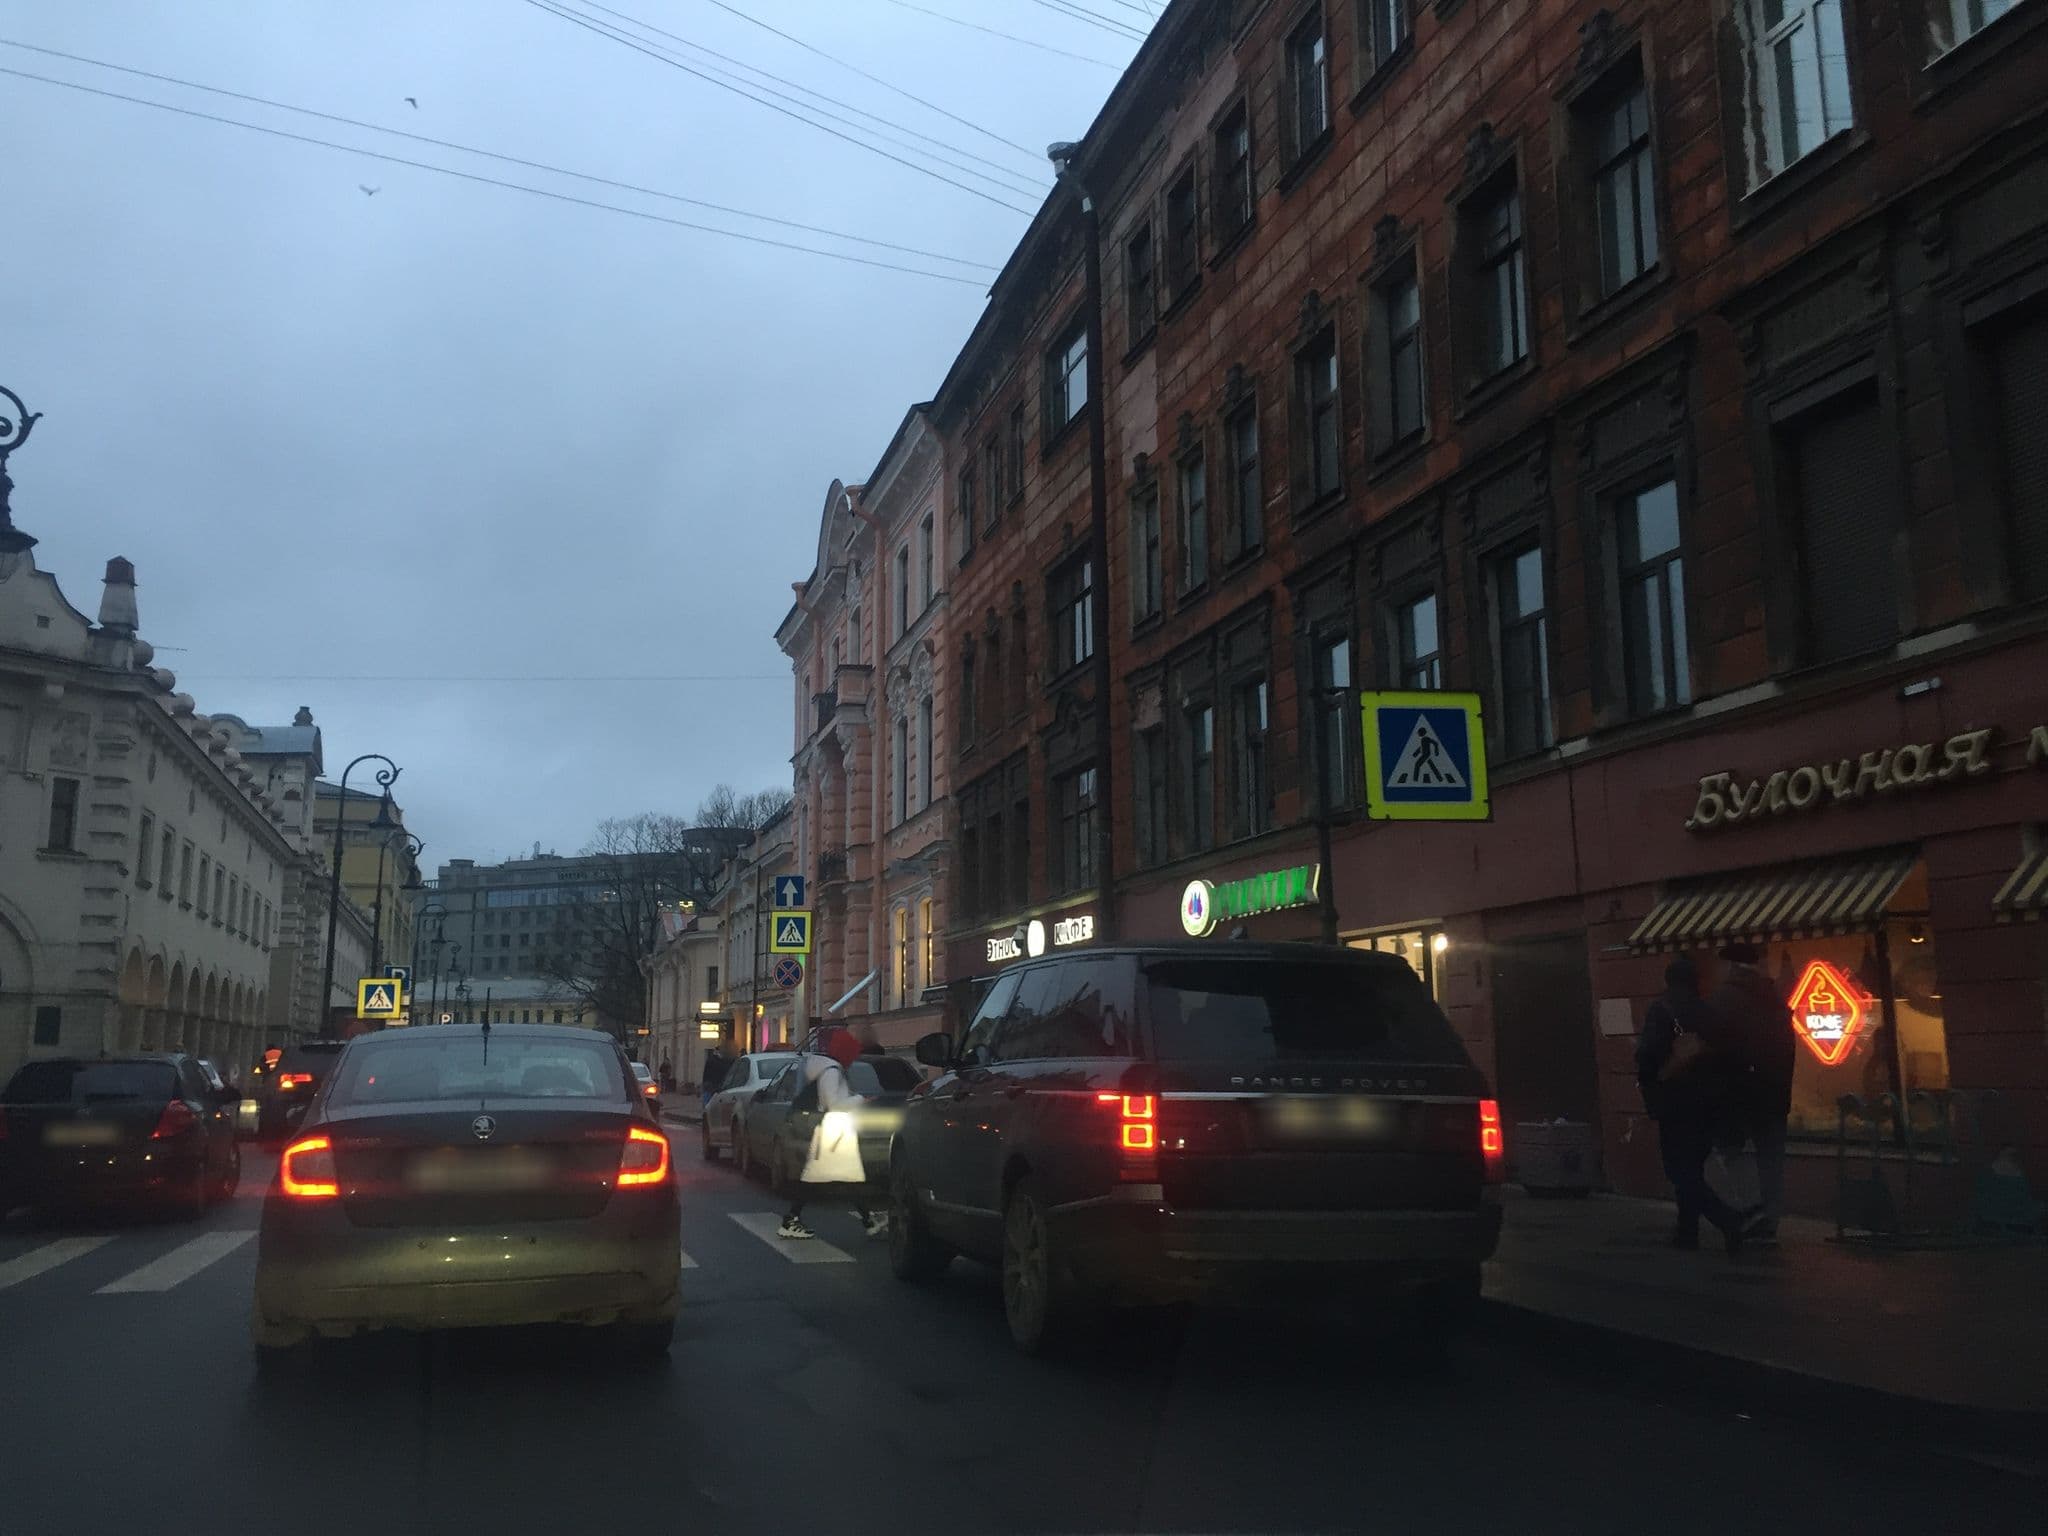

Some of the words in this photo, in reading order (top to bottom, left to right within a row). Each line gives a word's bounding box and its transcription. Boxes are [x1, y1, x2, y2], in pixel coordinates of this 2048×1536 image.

[1685, 728, 1992, 830] Булочная
[1054, 916, 1093, 945] КАФЕ
[441, 1014, 451, 1025] P
[1230, 1076, 1322, 1088] RANGE
[1341, 1077, 1427, 1089] ROVER
